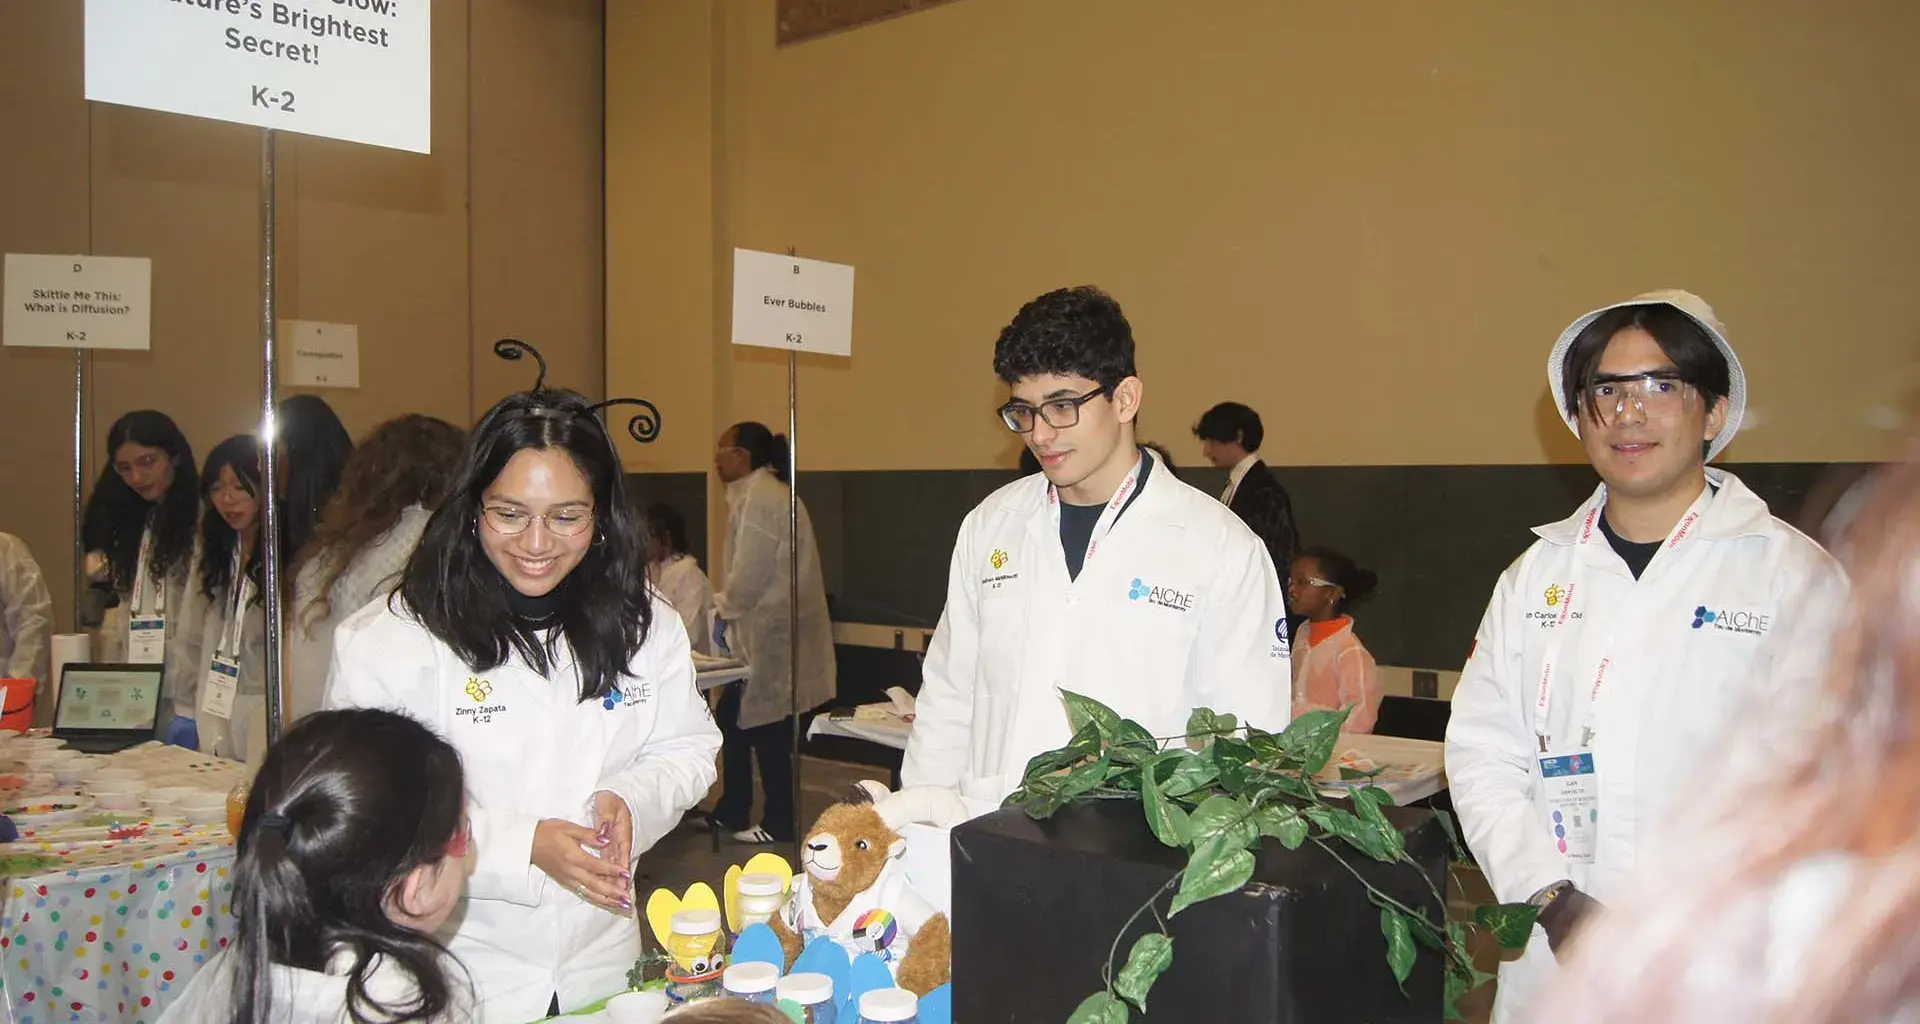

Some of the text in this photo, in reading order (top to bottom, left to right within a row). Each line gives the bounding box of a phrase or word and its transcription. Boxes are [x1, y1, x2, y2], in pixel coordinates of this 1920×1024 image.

[331, 0, 397, 18] ow:
[169, 0, 389, 48] ure's Brightest
[225, 27, 319, 65] Secret!
[251, 85, 296, 113] K-2
[73, 263, 82, 273] D
[793, 265, 800, 275] B
[32, 289, 122, 301] Skittle Me This:
[24, 302, 130, 315] What is Diffusion?
[763, 296, 826, 313] Ever Bubbles
[66, 331, 87, 341] K-2
[786, 333, 802, 344] K-2
[1148, 586, 1195, 608] AIChE
[1716, 609, 1769, 631] AIChE
[455, 704, 507, 716] Zinny Zapata
[472, 714, 491, 724] K-12
